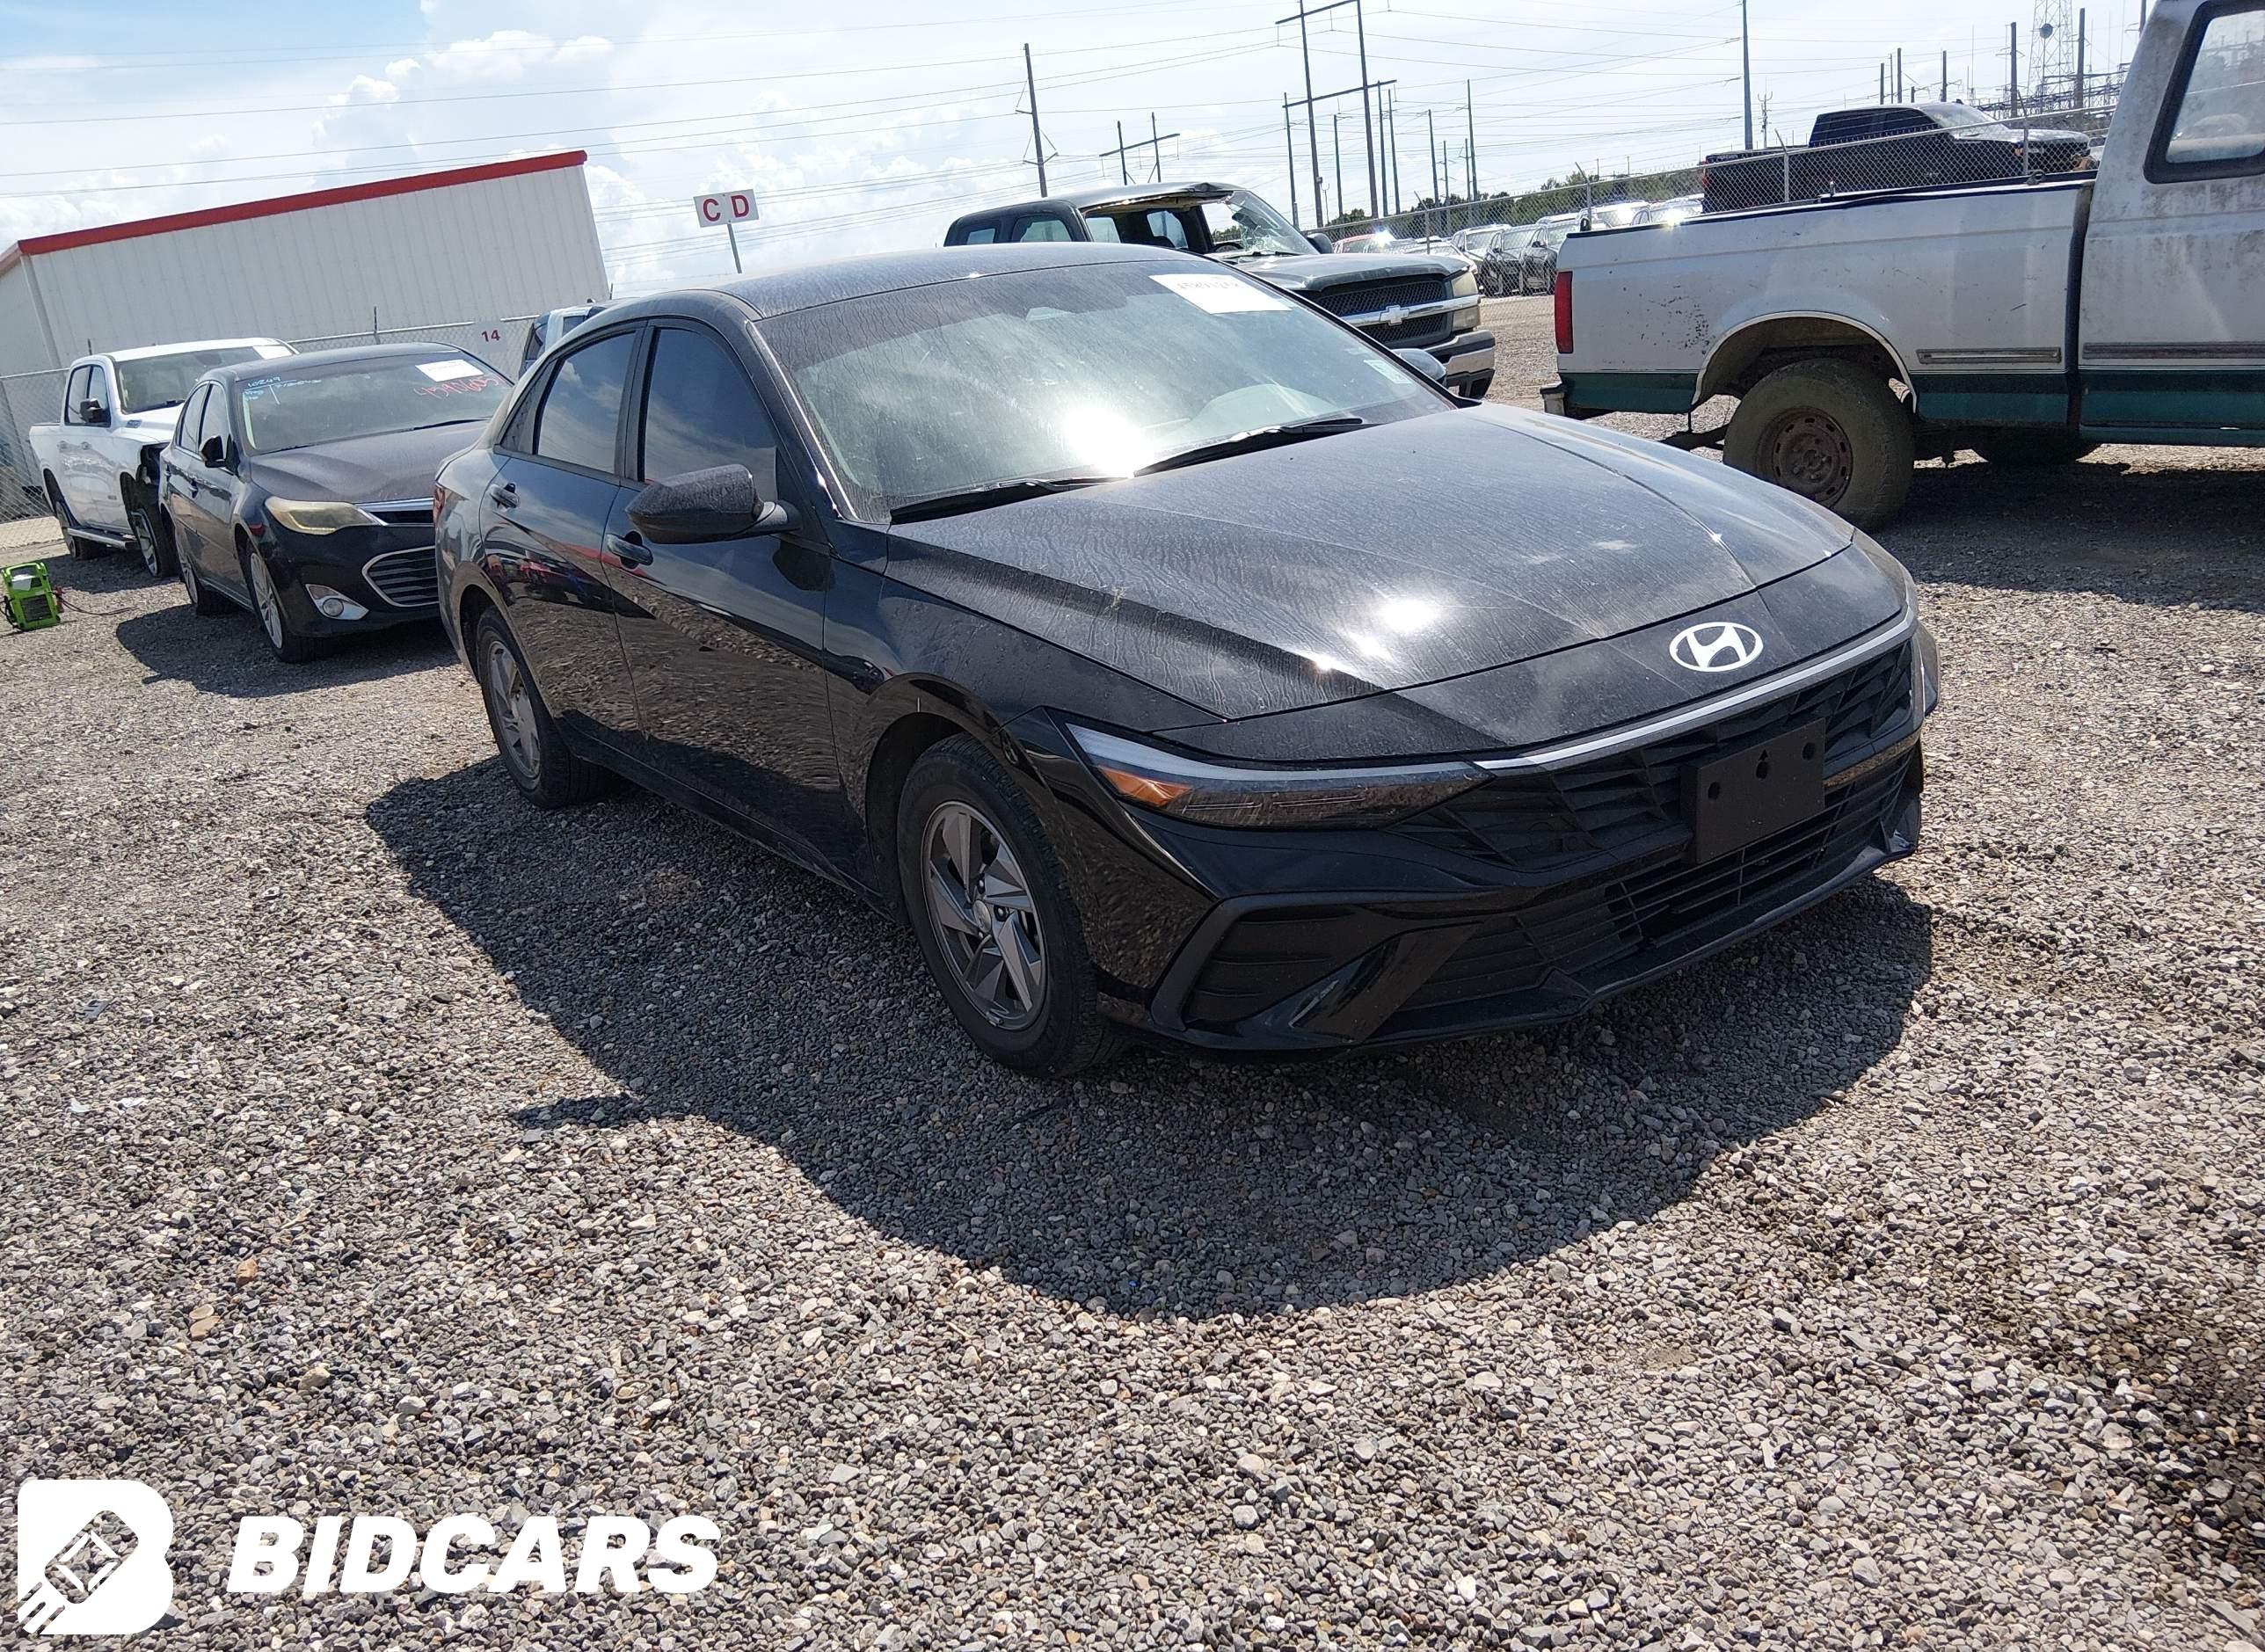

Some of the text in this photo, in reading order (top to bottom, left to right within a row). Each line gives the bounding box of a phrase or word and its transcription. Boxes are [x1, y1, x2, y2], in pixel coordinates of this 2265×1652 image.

[703, 194, 750, 222] C D
[481, 329, 500, 342] 14
